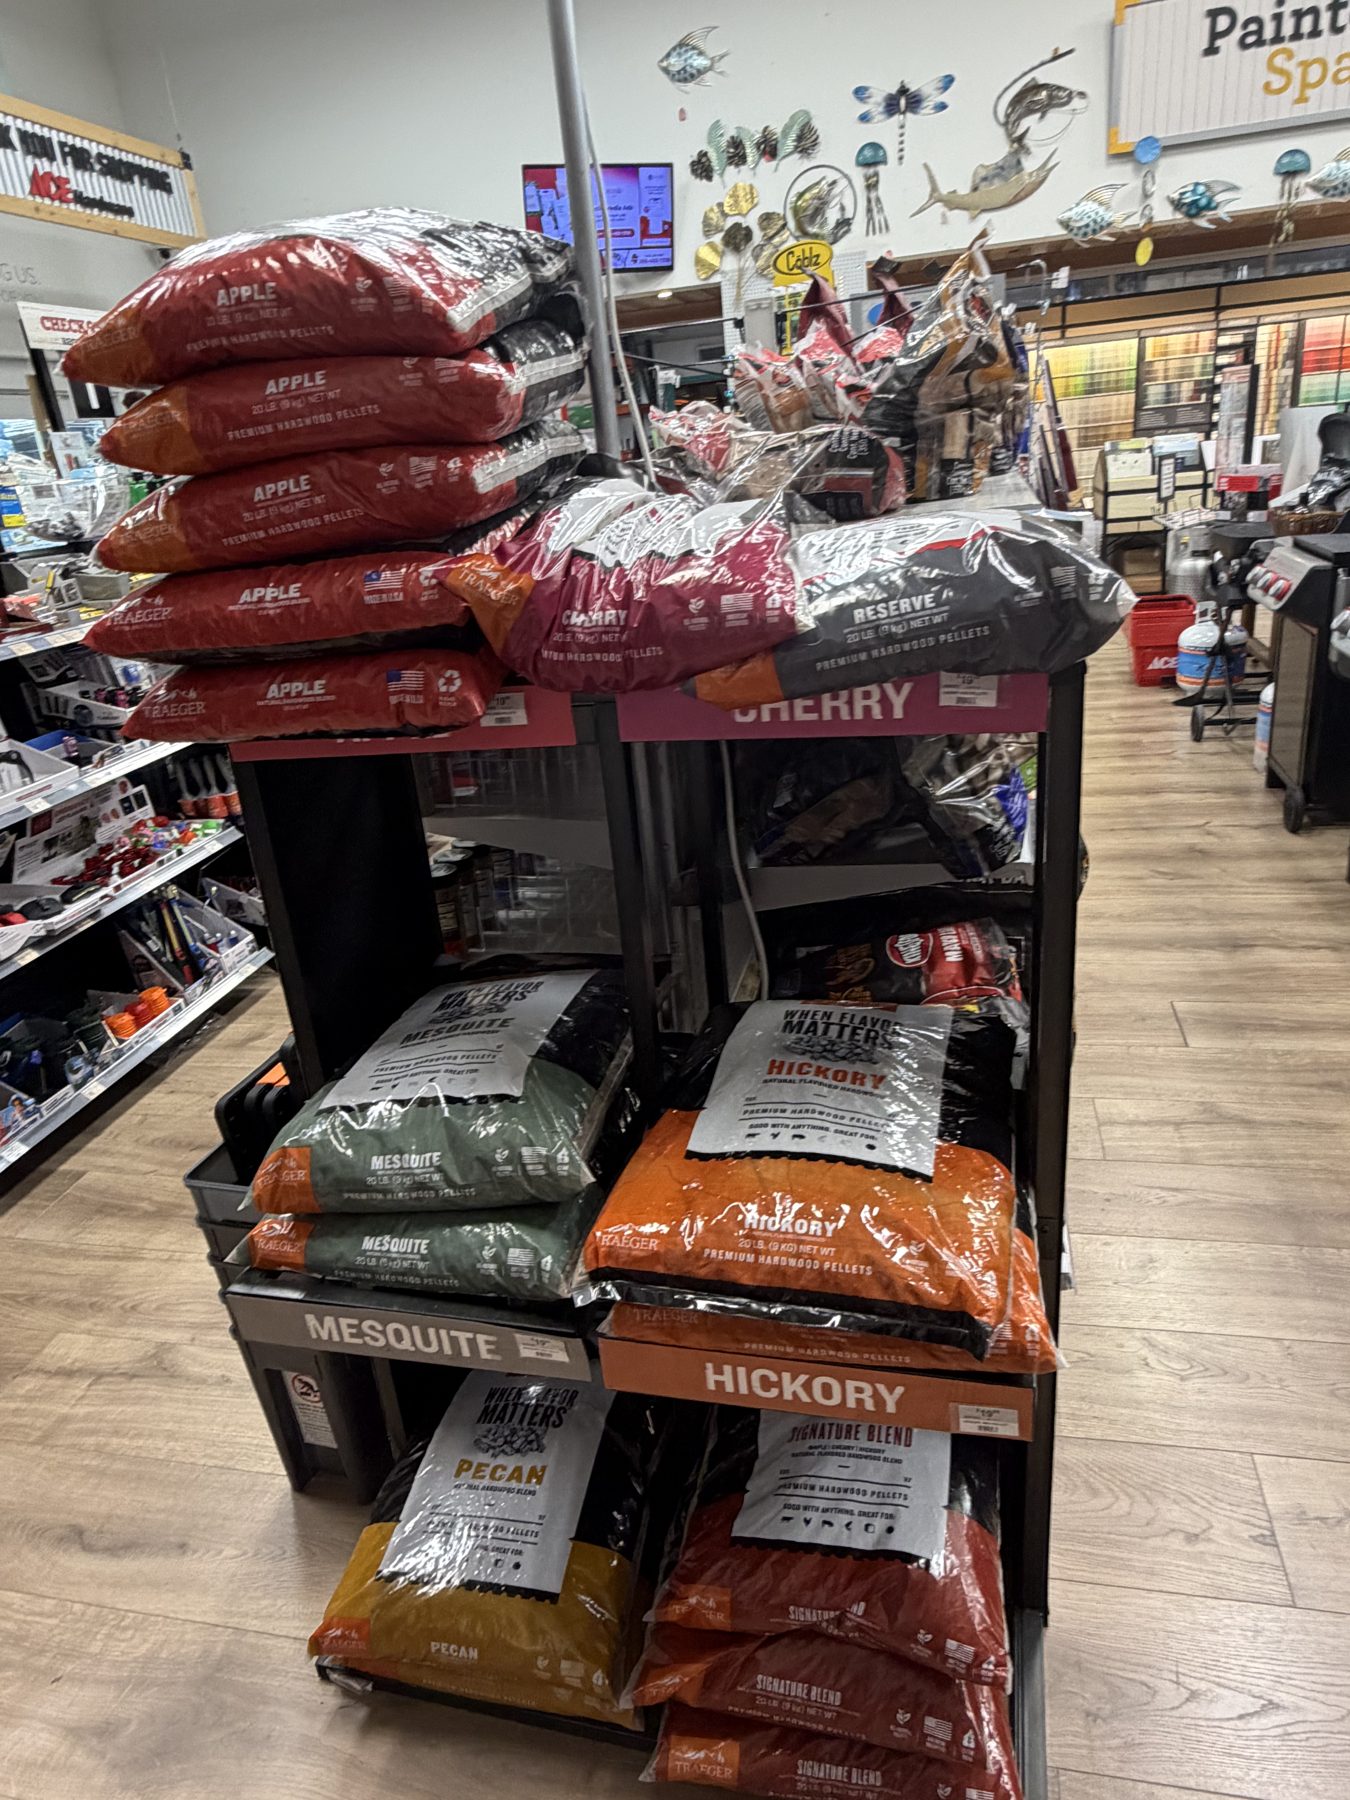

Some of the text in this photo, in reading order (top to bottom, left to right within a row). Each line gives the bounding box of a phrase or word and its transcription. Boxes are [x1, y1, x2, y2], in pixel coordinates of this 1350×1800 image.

[217, 282, 277, 306] APPLE
[265, 370, 327, 395] APPLE
[227, 422, 274, 441] PREMIUM
[336, 404, 380, 419] PELLETS
[253, 475, 311, 502] APPLE
[324, 507, 364, 525] PELLETS
[238, 583, 302, 604] APPLE
[106, 607, 174, 627] TRAEGER
[853, 593, 936, 625] RESERVE
[846, 634, 859, 644] 20
[910, 616, 930, 629] NET
[932, 612, 949, 624] WT
[815, 625, 991, 672] PREMIUM HARDWOOD PELLETS
[1147, 656, 1179, 670] ACE
[266, 680, 326, 700] APPLE
[144, 701, 206, 719] TRAEGER
[432, 989, 528, 1014] MATTERS
[784, 1009, 834, 1020] WHEN
[400, 1017, 516, 1045] MESQUITE
[782, 1020, 894, 1050] MATTERS
[767, 1058, 887, 1090] HICKORY
[743, 1107, 892, 1129] PREMIUM HARDWOOD PELLET
[771, 1122, 790, 1130] WITH
[833, 1128, 858, 1138] GREAT
[371, 1152, 442, 1170] MESQUITE
[744, 1213, 838, 1237] HICKORY
[361, 1235, 431, 1255] MESQUITE
[595, 1231, 659, 1251] TRAEGER
[738, 1238, 751, 1249] 20
[768, 1242, 780, 1252] (9
[781, 1242, 797, 1253] KG)
[800, 1244, 819, 1255] NET
[821, 1246, 836, 1256] WT
[704, 1249, 873, 1276] PREMIUM HARDWOOD PELLETS
[633, 1309, 699, 1324] TRAEGER
[304, 1313, 503, 1361] MESQUITE
[744, 1342, 911, 1364] PREMIUM HARDWOOD PELLETS
[484, 1386, 524, 1405] WHEN
[705, 1362, 905, 1414] HICKORY
[476, 1403, 568, 1429] MATTERS
[788, 1422, 913, 1448] SIGNATURE BLEND
[453, 1458, 548, 1487] PECAN
[818, 1485, 868, 1497] HARDWOOD
[870, 1490, 909, 1501] PELLETS
[802, 1504, 820, 1513] WITH
[430, 1641, 478, 1660] PECAN
[756, 1674, 843, 1706] SIGNATURE BLEND
[675, 1761, 733, 1780] TRAEGER
[797, 1759, 883, 1786] SIGNATURE BLEND
